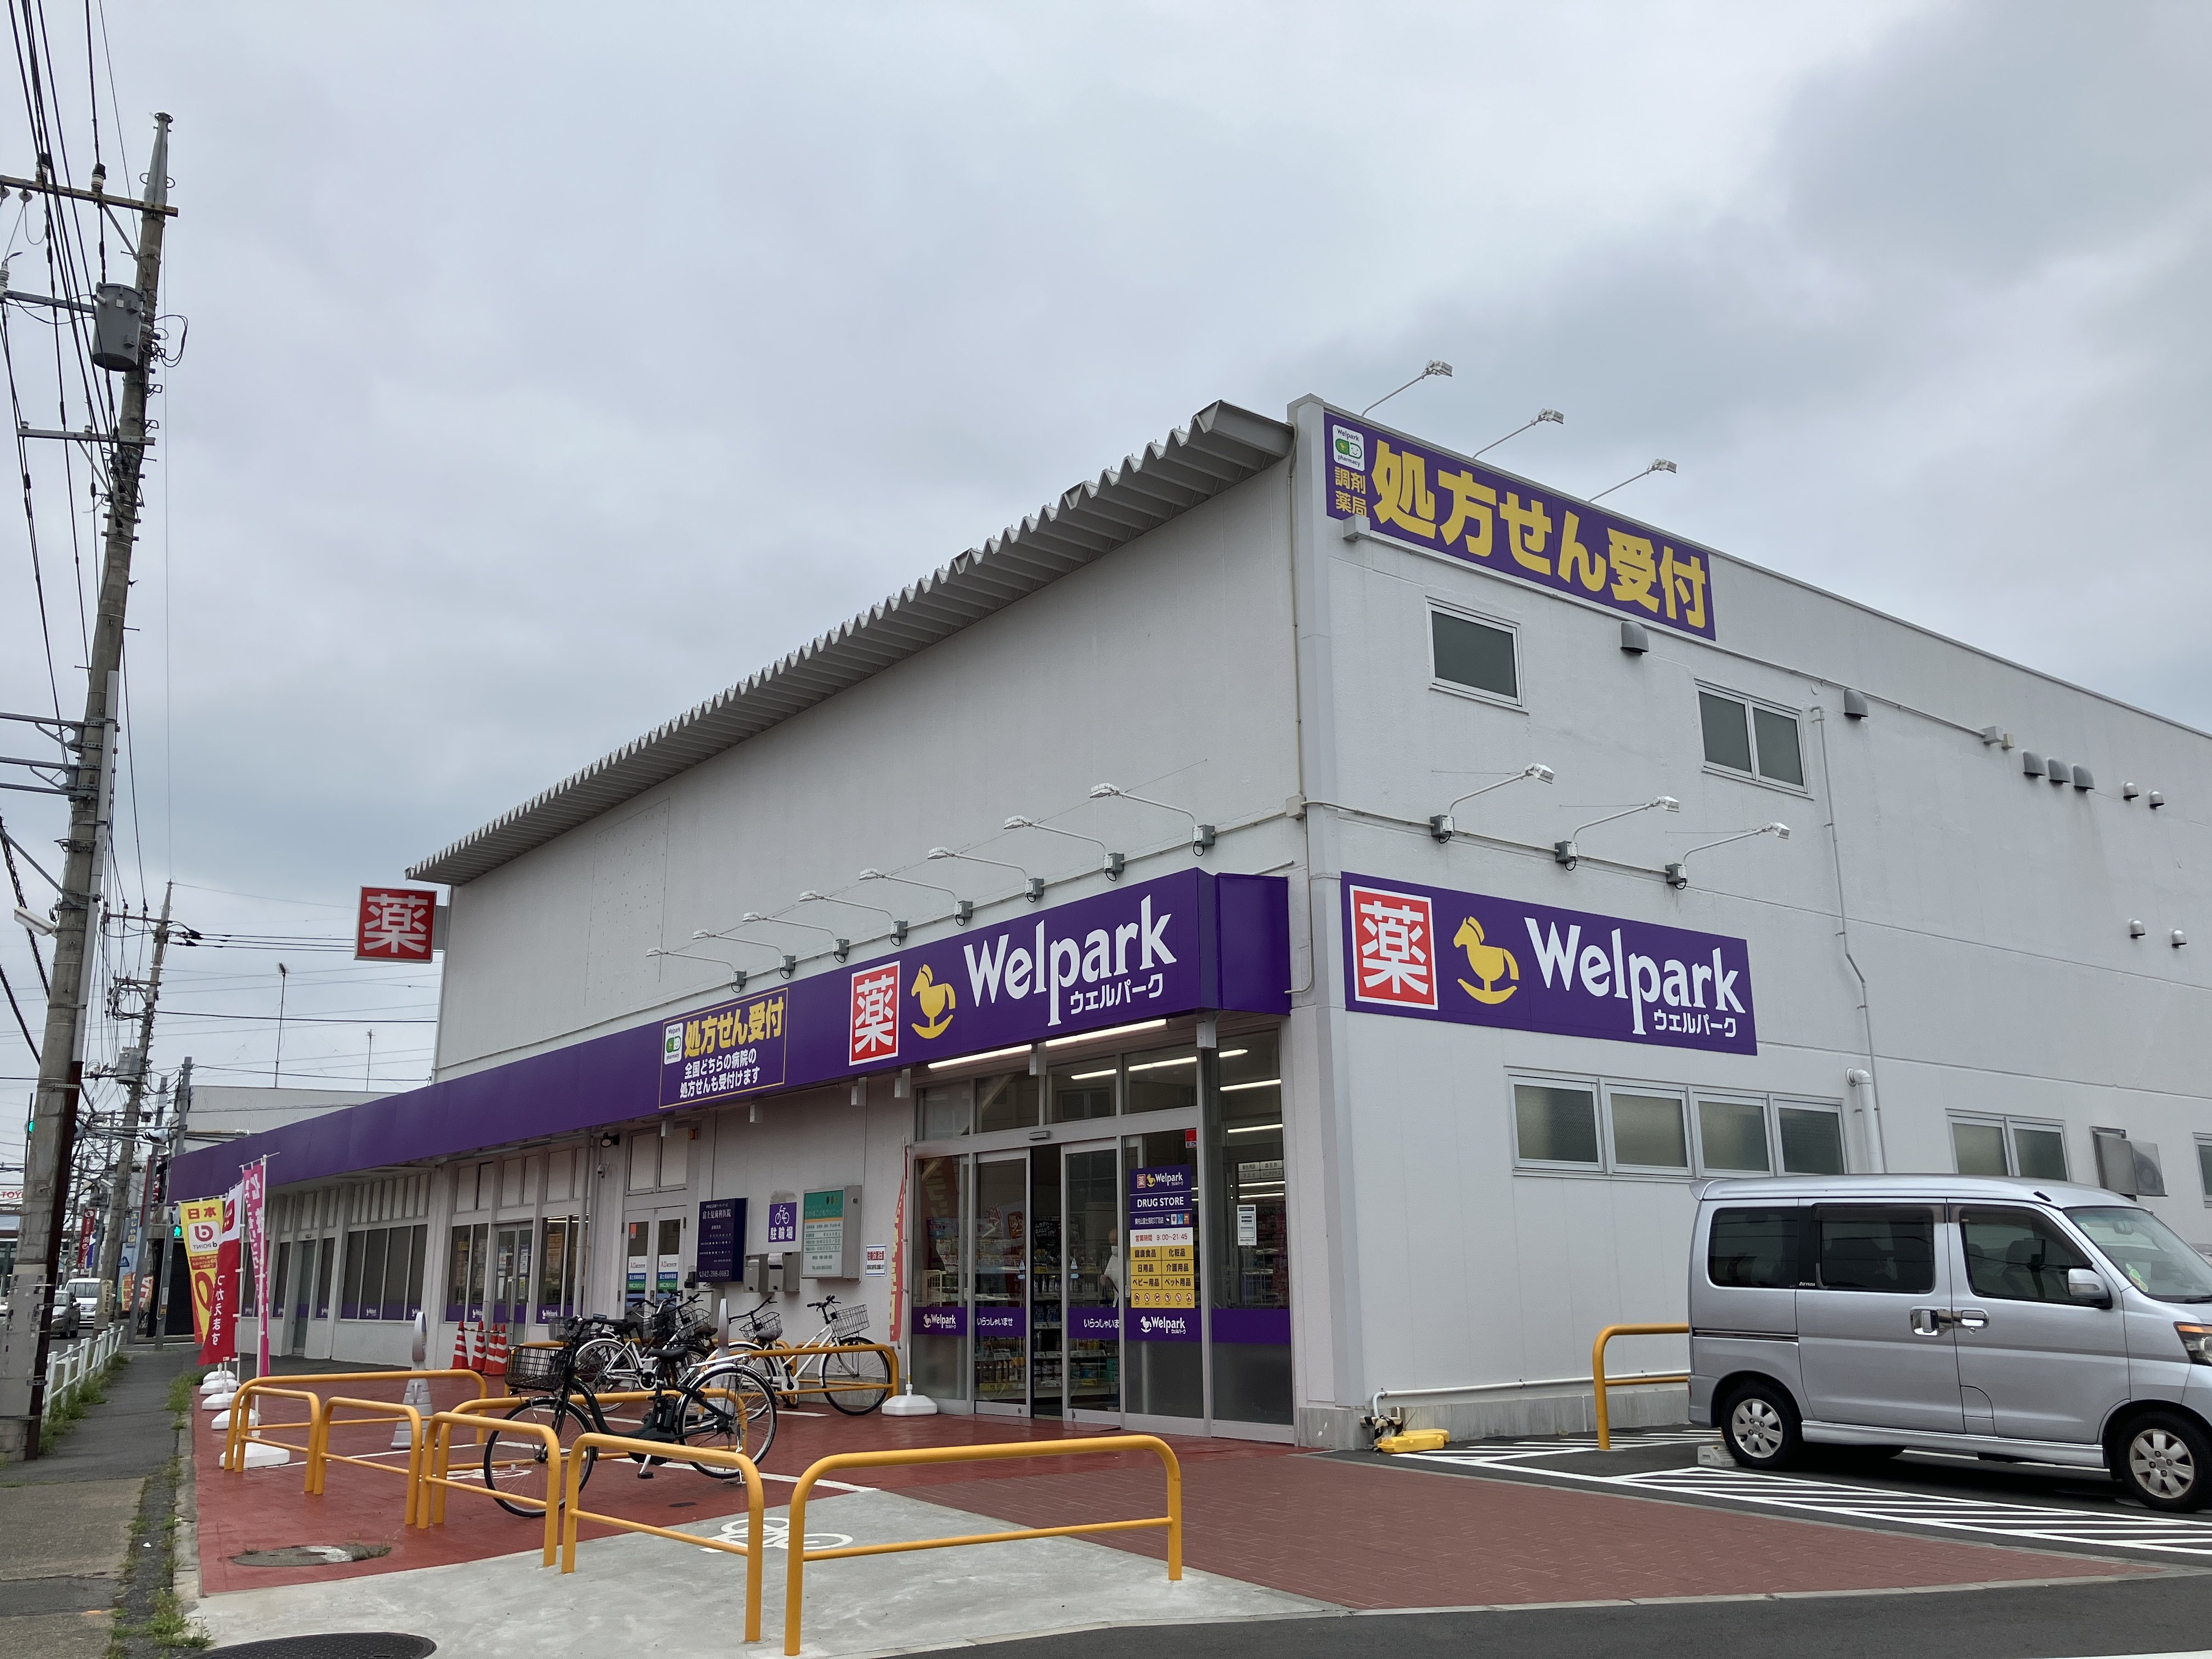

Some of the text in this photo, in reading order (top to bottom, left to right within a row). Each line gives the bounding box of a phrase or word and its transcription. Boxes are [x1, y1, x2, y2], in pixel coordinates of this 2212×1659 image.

[1337, 428, 1359, 441] Welpark
[1338, 455, 1360, 467] pharmacy
[1335, 466, 1366, 494] 調剤
[1335, 490, 1367, 517] 薬局
[1372, 439, 1706, 629] 処方せん受付
[363, 893, 428, 953] 薬
[1359, 900, 1430, 995] 薬
[963, 894, 1177, 1026] Welpark
[1524, 917, 1746, 1035] Welpark
[854, 974, 895, 1053] 薬
[684, 996, 783, 1059] 処方せん受付
[684, 1048, 757, 1079] 全国どちらの病院の
[680, 1066, 760, 1099] 処方せんも受付けます
[1155, 1172, 1183, 1186] Welpark
[1137, 1197, 1184, 1207] DRUG STORE
[770, 1226, 793, 1240] 駐輪場
[1135, 1249, 1186, 1258] 健康食品 化粧品
[1138, 1263, 1189, 1272] 日用品 介護用品
[1132, 1278, 1191, 1286] ベビー用品 ペット用品
[931, 1314, 956, 1329] Welpark
[977, 1317, 1013, 1326] いらっしゃいませ
[1084, 1318, 1120, 1328] いらっしゃいま
[1151, 1316, 1186, 1334] Welpark
